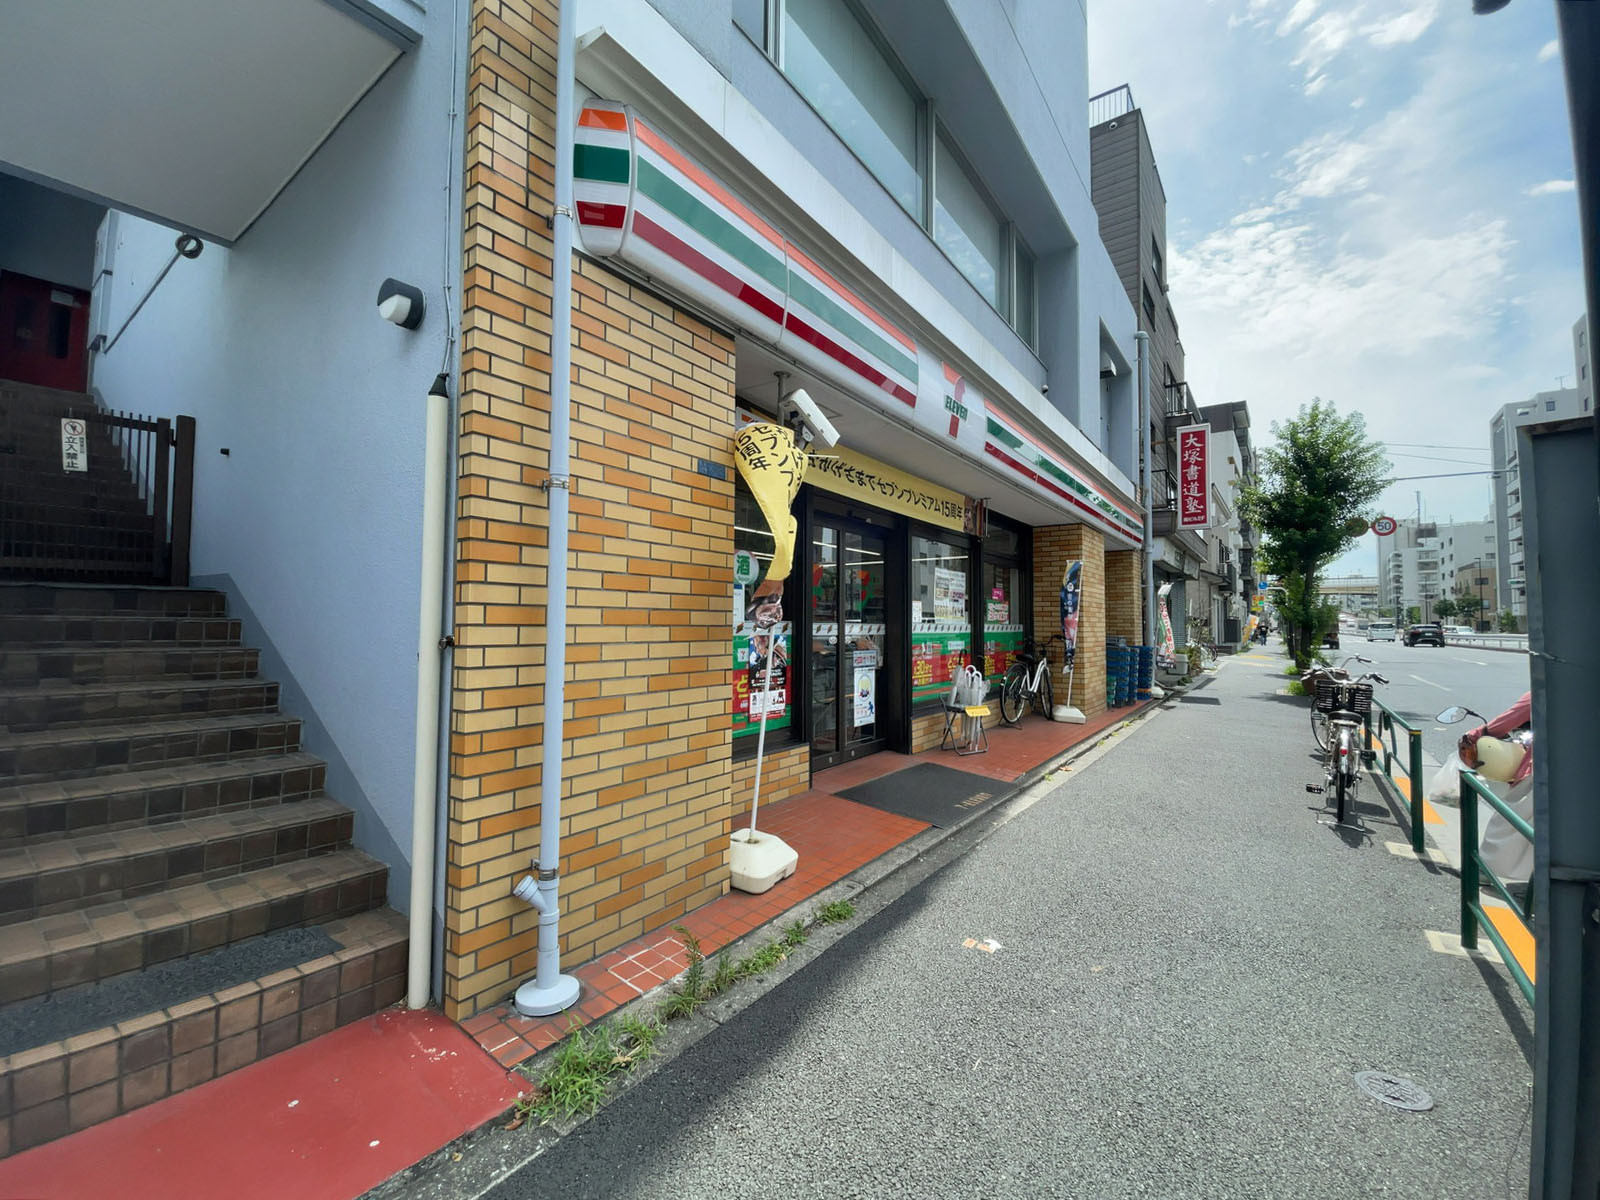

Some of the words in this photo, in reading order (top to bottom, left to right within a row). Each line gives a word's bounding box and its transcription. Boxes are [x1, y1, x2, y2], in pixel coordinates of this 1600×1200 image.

[64, 436, 79, 469] 立入禁止
[1183, 433, 1204, 514] 大塚書道塾
[1377, 521, 1392, 531] 50
[737, 554, 750, 576] 酒
